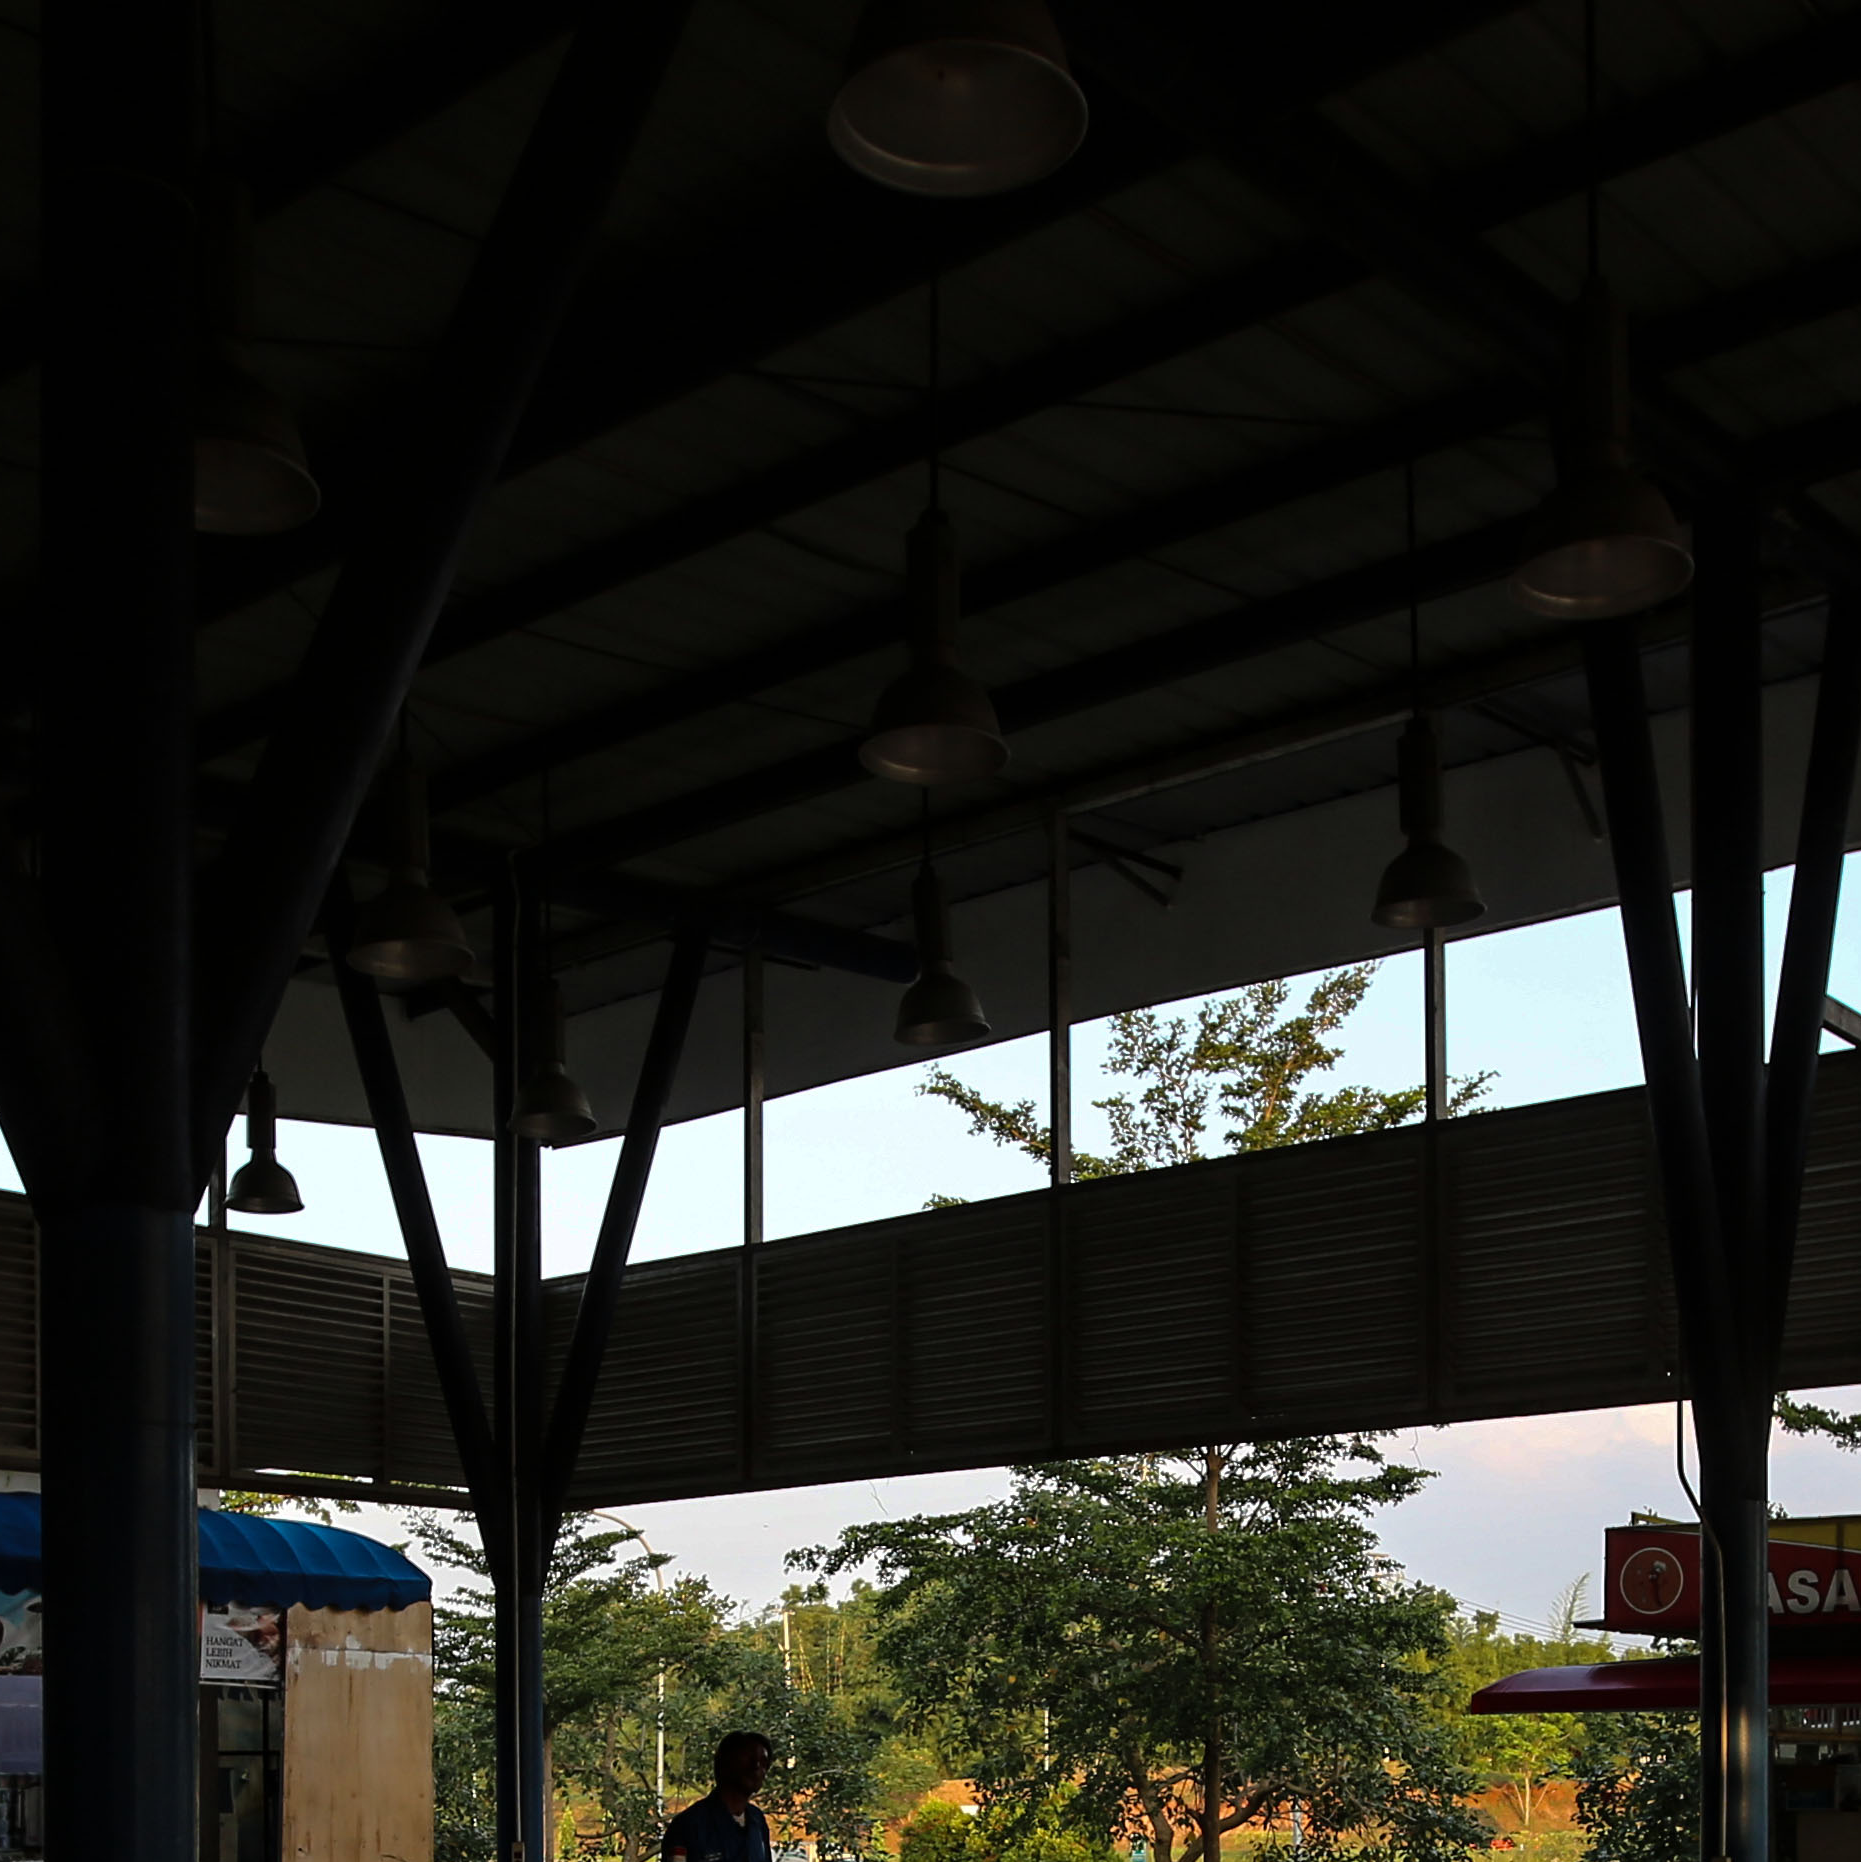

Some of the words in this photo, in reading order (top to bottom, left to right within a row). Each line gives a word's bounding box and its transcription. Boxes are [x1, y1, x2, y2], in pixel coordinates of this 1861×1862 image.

[206, 1636, 243, 1647] HANGAT
[206, 1647, 233, 1657] LEBIH
[206, 1659, 242, 1669] NIKMAT
